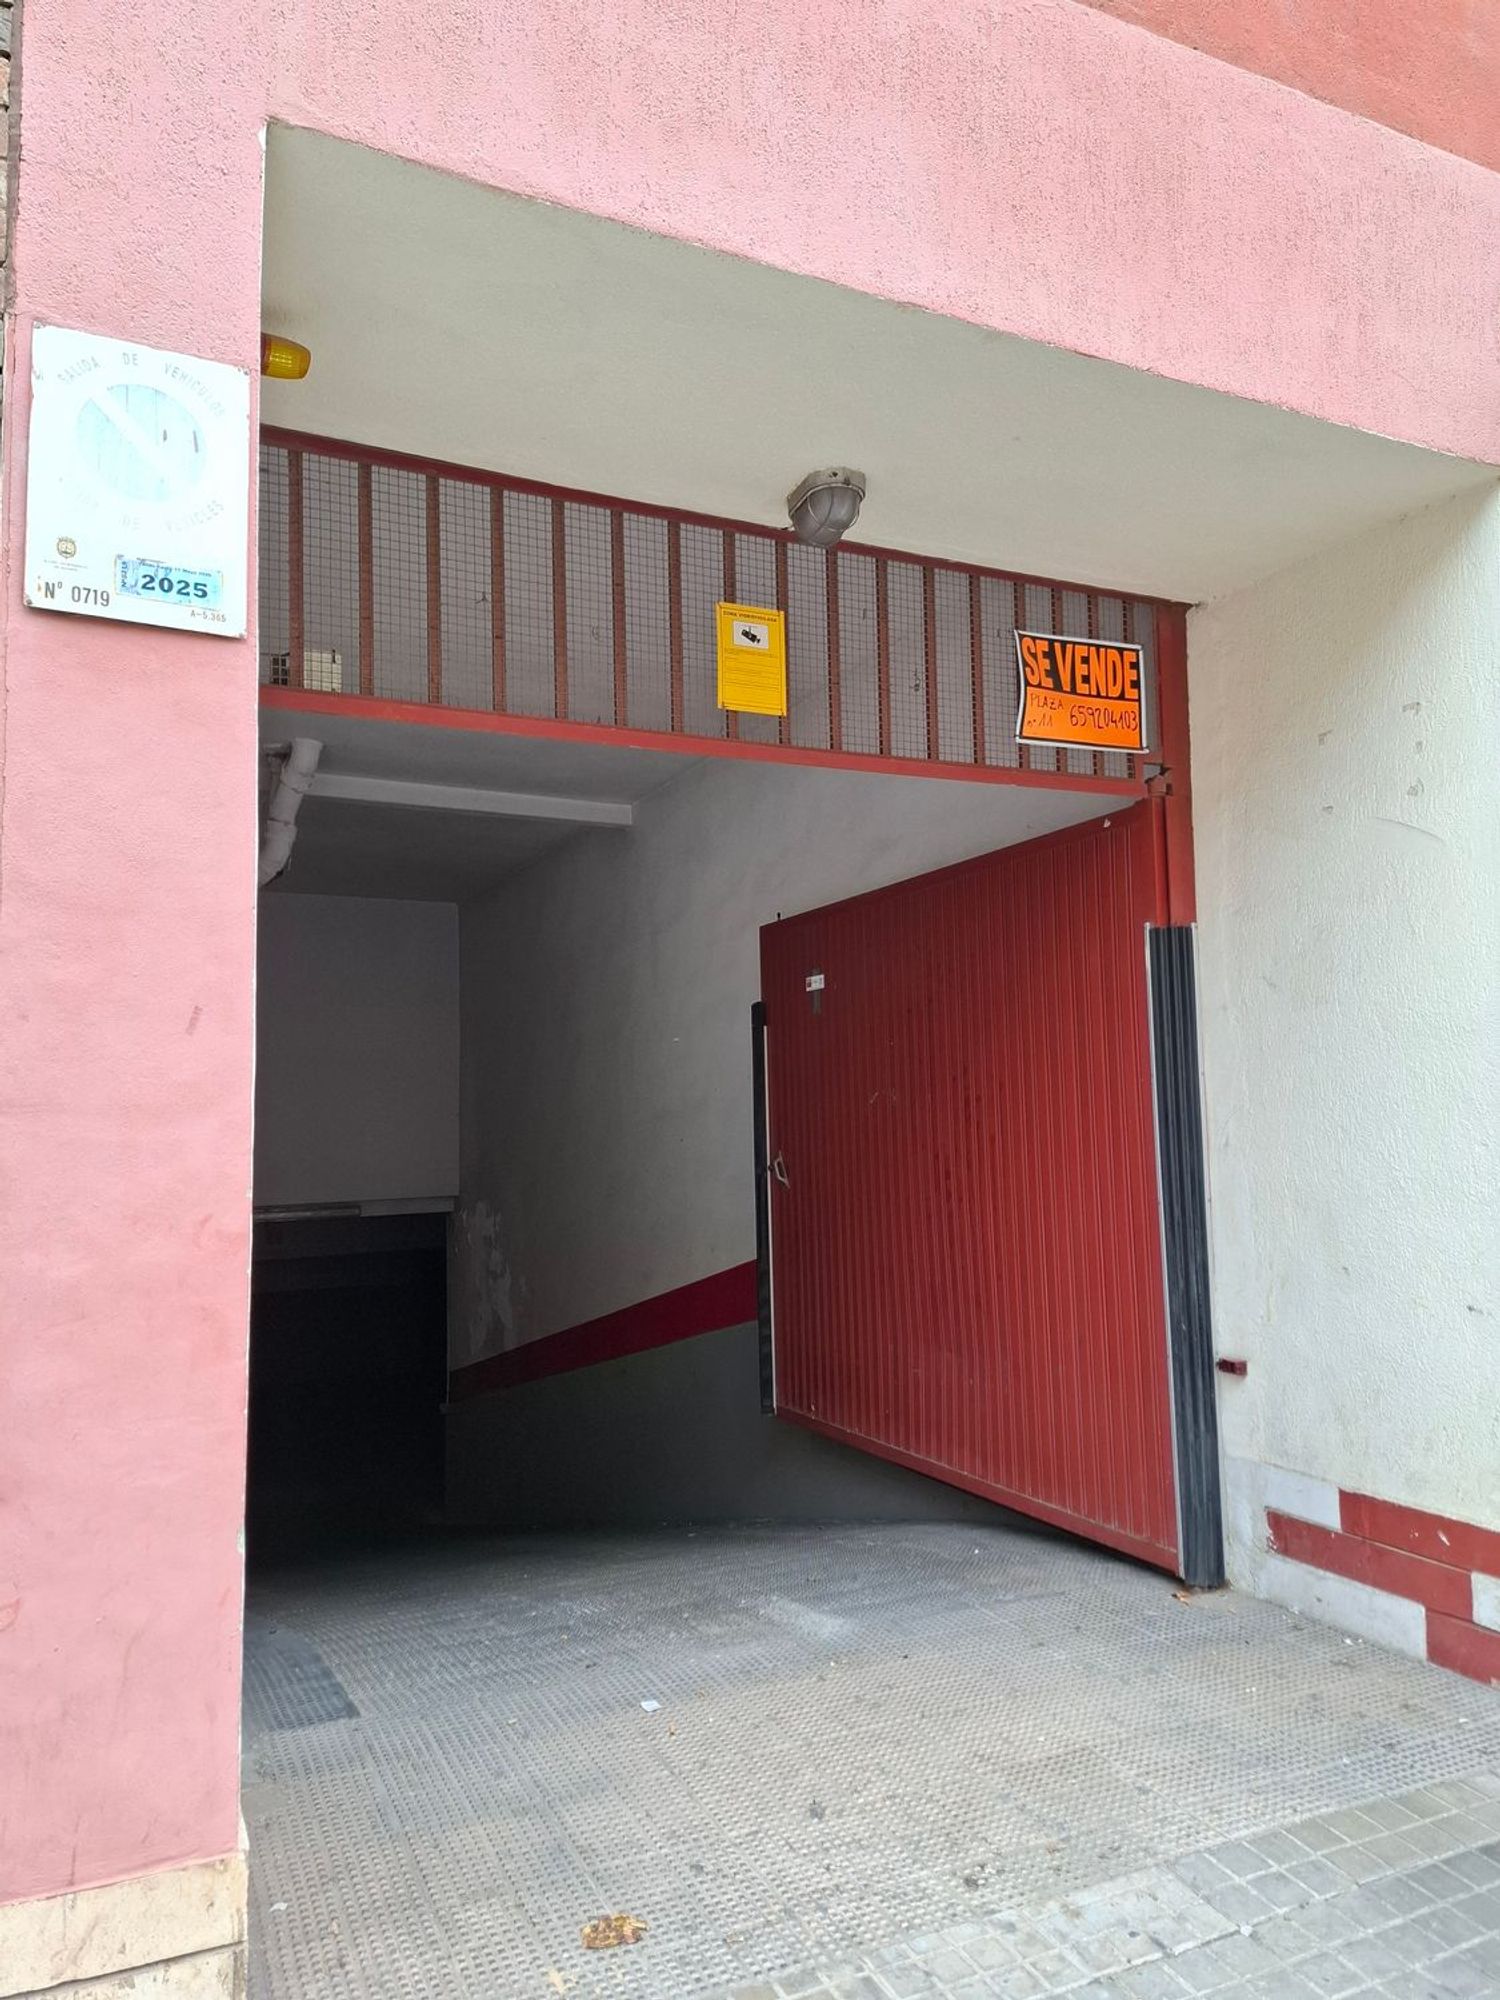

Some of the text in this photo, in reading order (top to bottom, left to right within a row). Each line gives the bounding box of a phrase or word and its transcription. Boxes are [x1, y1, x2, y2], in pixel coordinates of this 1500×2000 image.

[57, 355, 101, 384] SALIDA
[122, 352, 138, 366] DE
[71, 585, 110, 607] 0719
[141, 574, 208, 599] 2025
[1021, 637, 1139, 700] SE VENDE
[1030, 692, 1064, 711] PLAZA
[1069, 704, 1139, 731] 659204103
